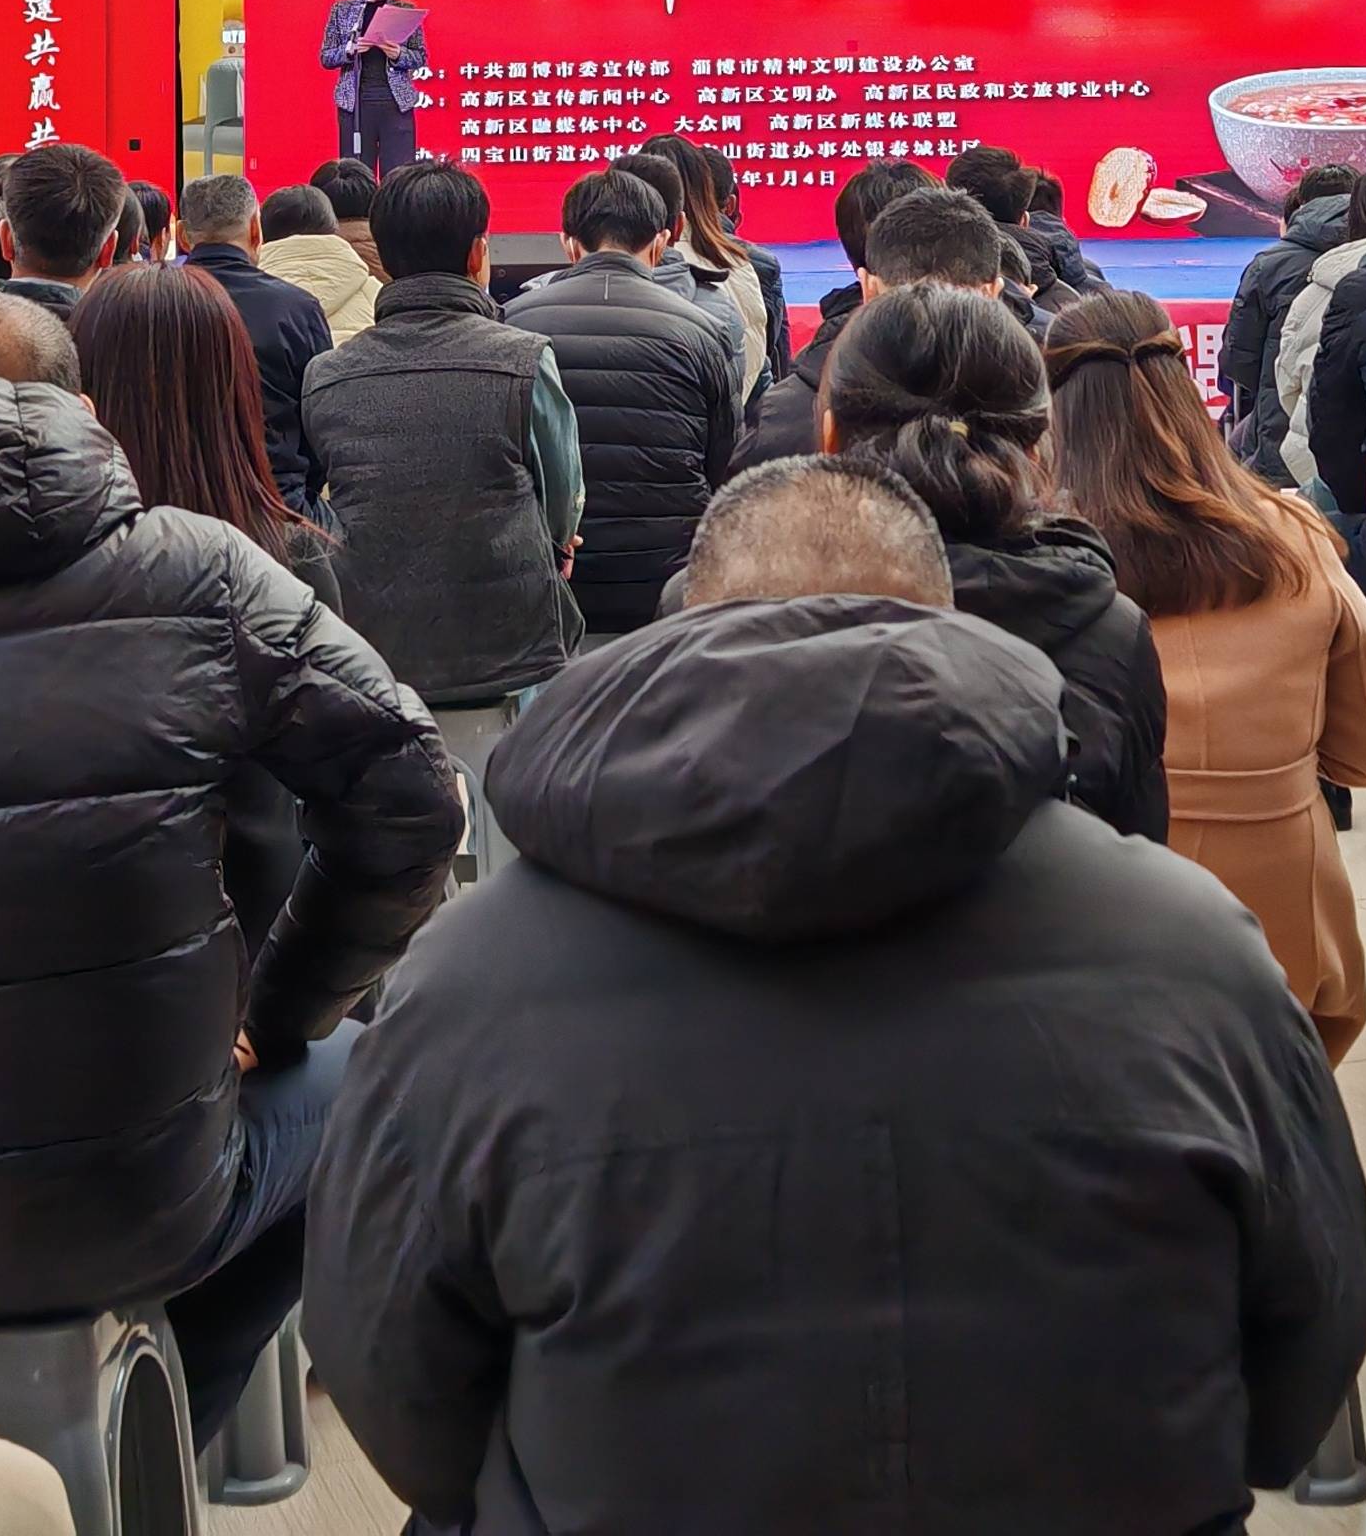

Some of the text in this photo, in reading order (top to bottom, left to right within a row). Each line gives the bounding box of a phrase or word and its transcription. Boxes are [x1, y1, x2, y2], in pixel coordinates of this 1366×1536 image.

[460, 59, 671, 81] 中共淄博市委宣传部
[691, 54, 975, 77] 淄博市精神文明建设办公室
[460, 87, 672, 108] 高新区宣传新闻中心
[697, 84, 838, 105] 高新区文明办
[863, 79, 1151, 102] 高新区民政和文旅事业中心
[460, 111, 958, 136] 高新区融媒体中心 大众网 高新区新媒体联盟
